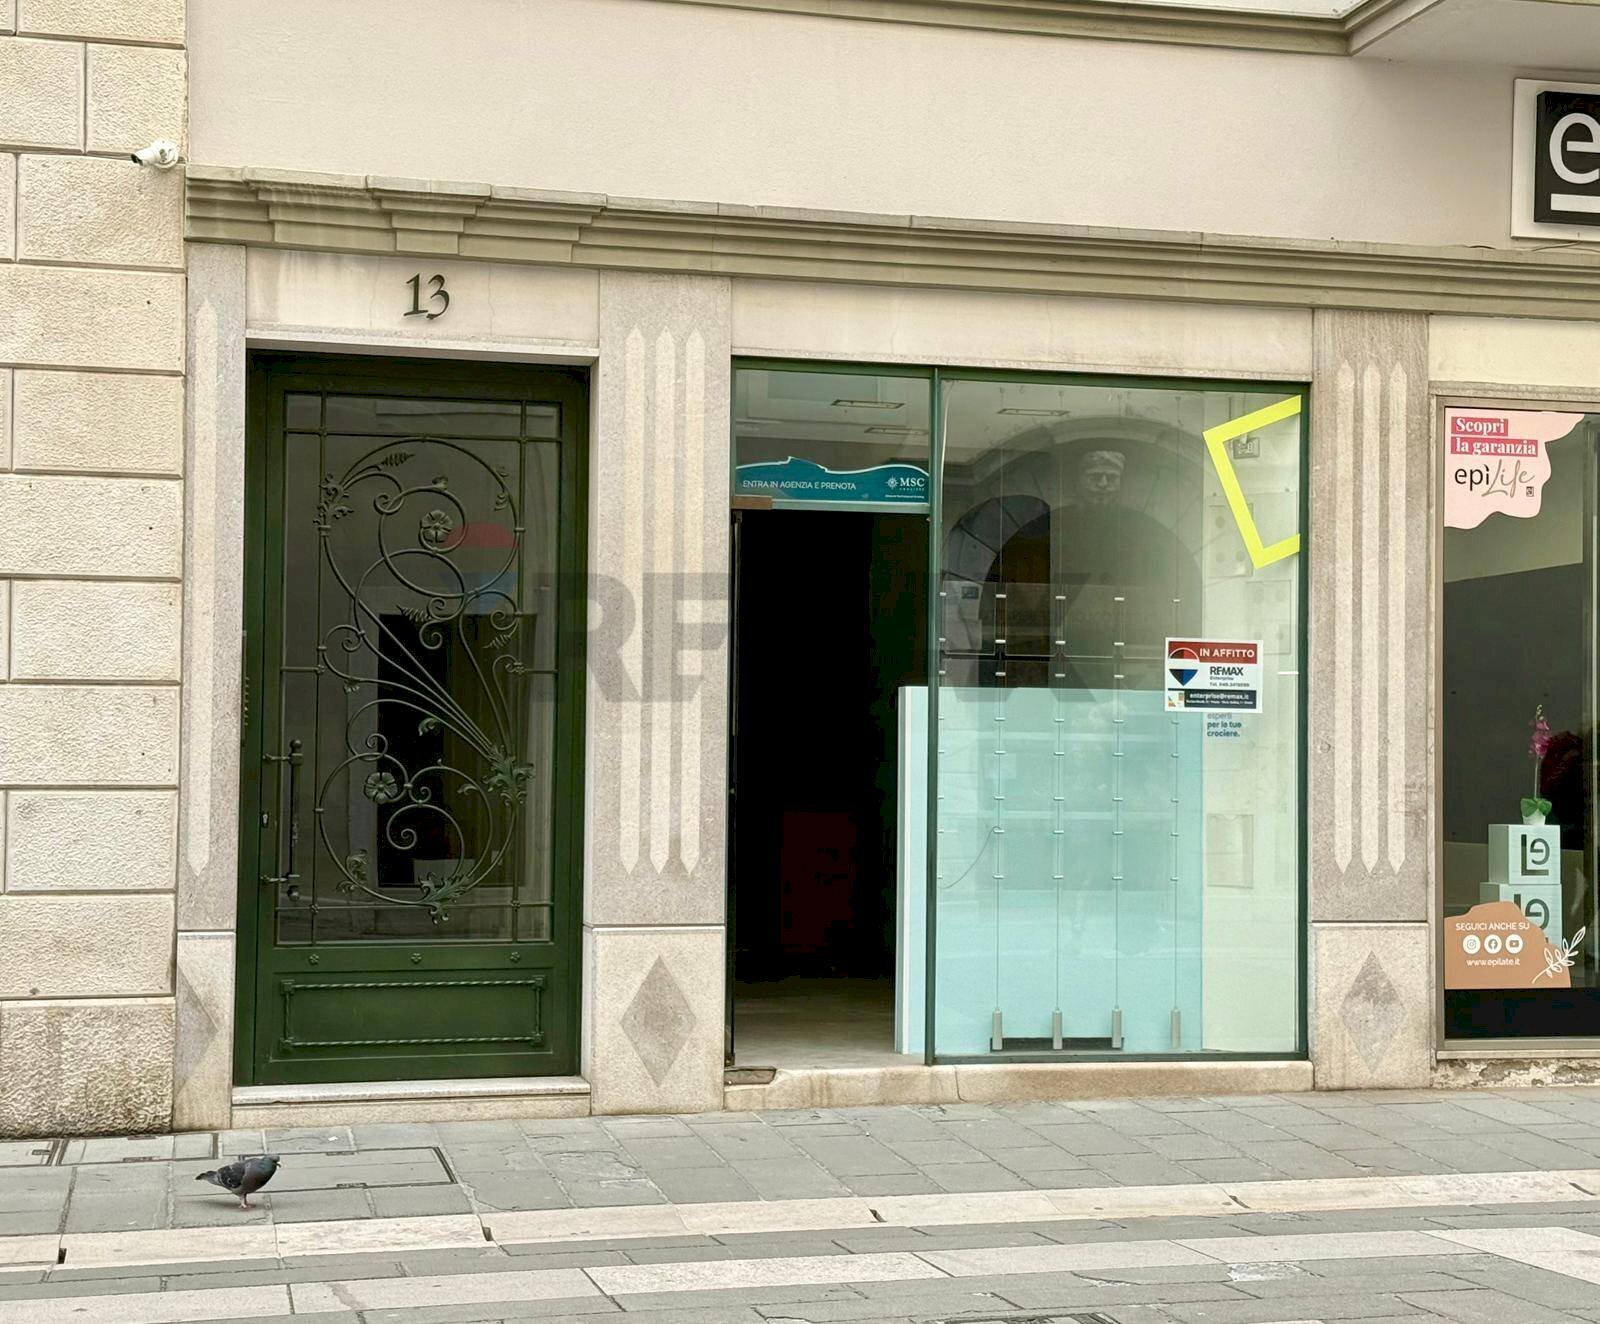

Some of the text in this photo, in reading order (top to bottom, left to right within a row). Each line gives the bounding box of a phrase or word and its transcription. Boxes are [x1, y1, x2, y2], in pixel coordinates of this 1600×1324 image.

[403, 273, 450, 320] 13
[1456, 417, 1504, 435] Scopri
[1456, 437, 1536, 456] la garanzia
[742, 480, 769, 489] ENTRA
[770, 481, 779, 489] IN
[780, 481, 813, 489] AGENZIA
[821, 482, 856, 490] PRENOTA
[899, 477, 925, 487] MSC
[1199, 648, 1255, 658] IN AFFITTO
[1207, 722, 1220, 730] per
[1455, 922, 1530, 931] SEGUICI ANCHE SU
[1466, 957, 1521, 968] www.epilate.it
